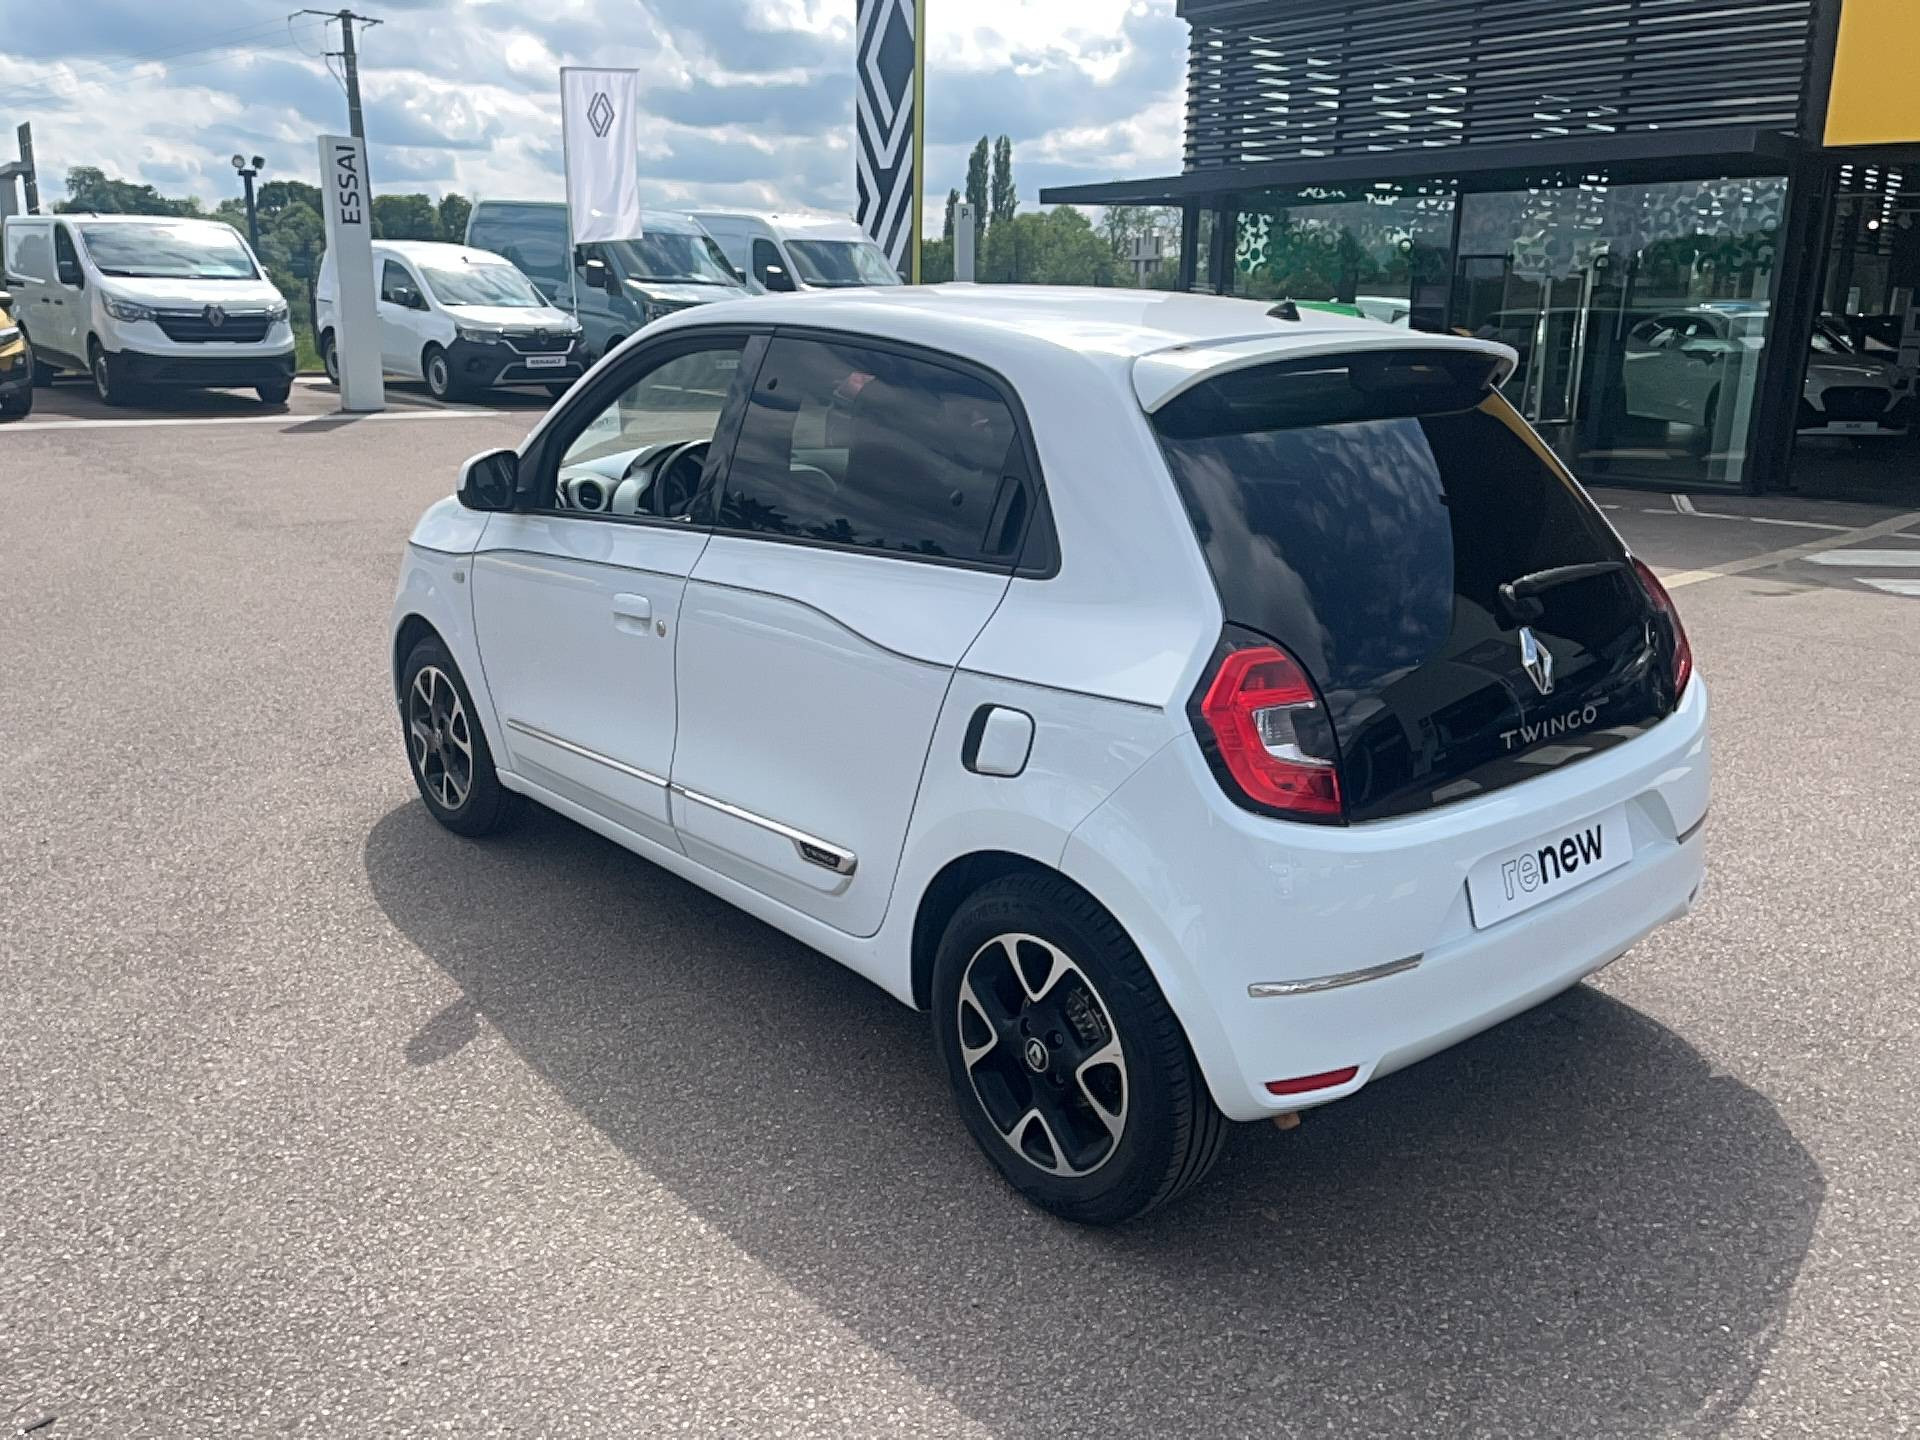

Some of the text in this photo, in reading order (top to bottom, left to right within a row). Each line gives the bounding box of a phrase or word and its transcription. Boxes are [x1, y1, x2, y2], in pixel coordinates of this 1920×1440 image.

[335, 145, 362, 226] ESSAI
[1499, 704, 1598, 750] TWINGO
[1501, 824, 1602, 901] renew
